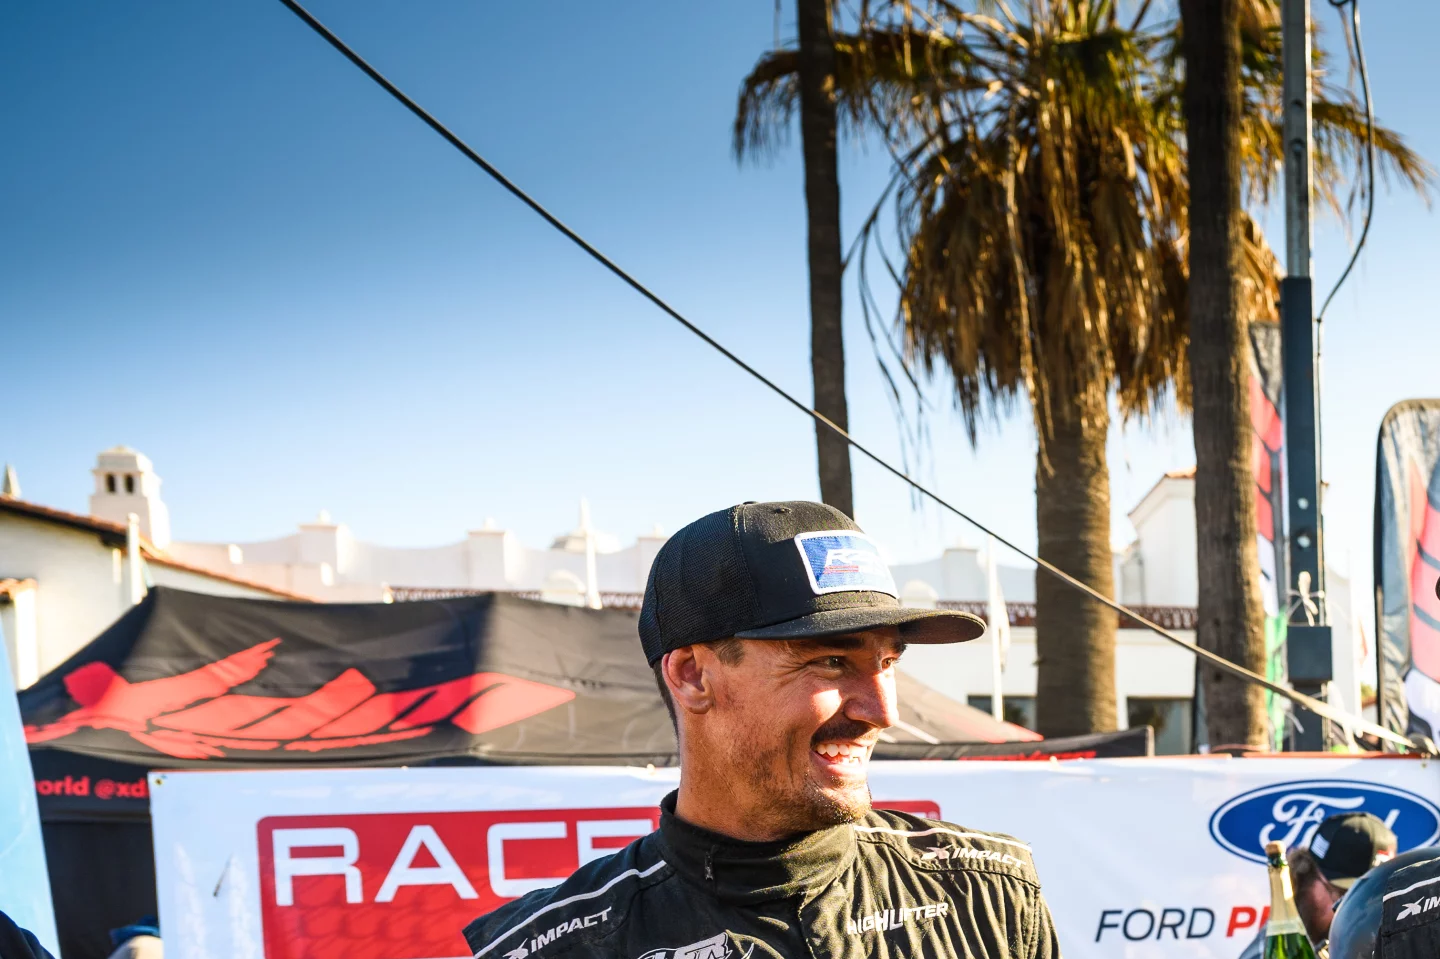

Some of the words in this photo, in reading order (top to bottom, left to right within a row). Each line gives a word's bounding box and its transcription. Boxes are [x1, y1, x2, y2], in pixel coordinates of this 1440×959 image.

[951, 847, 1027, 868] IMPACT
[530, 906, 612, 953] IMPACT
[1095, 908, 1216, 942] FORD
